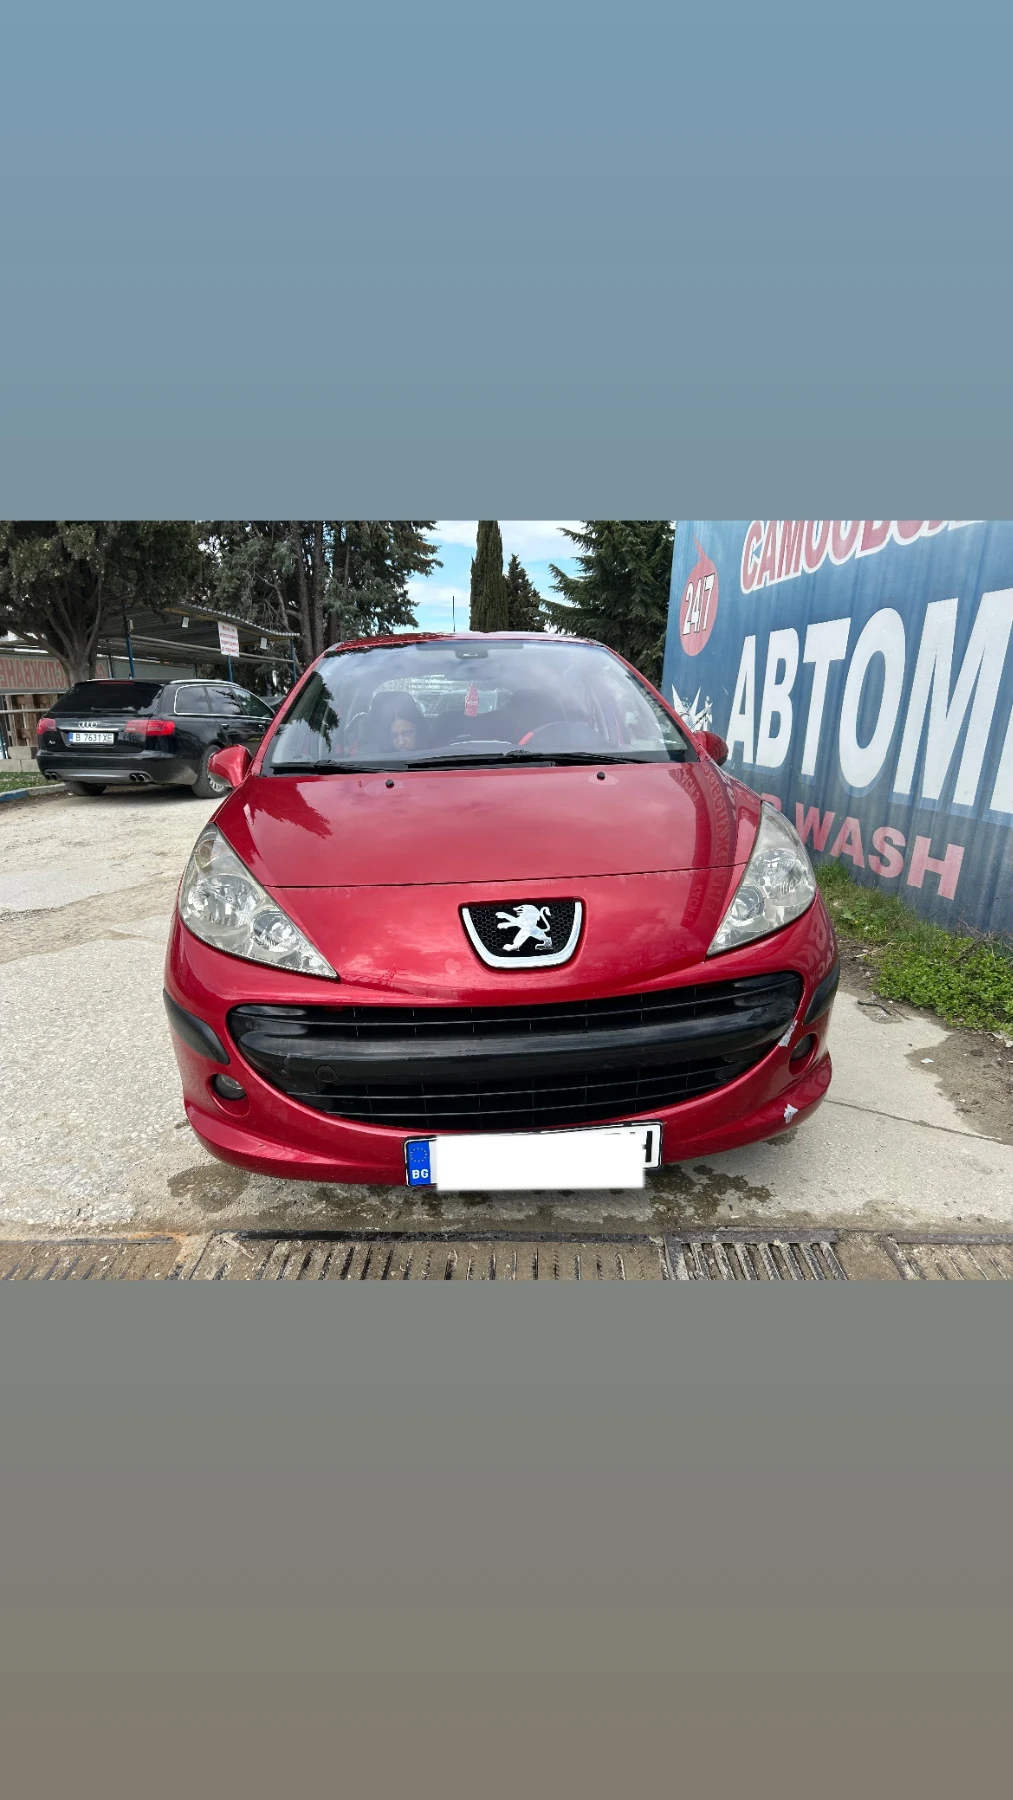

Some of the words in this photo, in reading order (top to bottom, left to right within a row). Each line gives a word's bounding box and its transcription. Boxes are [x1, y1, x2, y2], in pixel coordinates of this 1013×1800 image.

[682, 572, 716, 636] 24/7
[726, 588, 1013, 814] АВТОМ
[84, 733, 101, 742] 7631
[795, 801, 965, 901] WASH
[411, 1168, 429, 1180] BG
